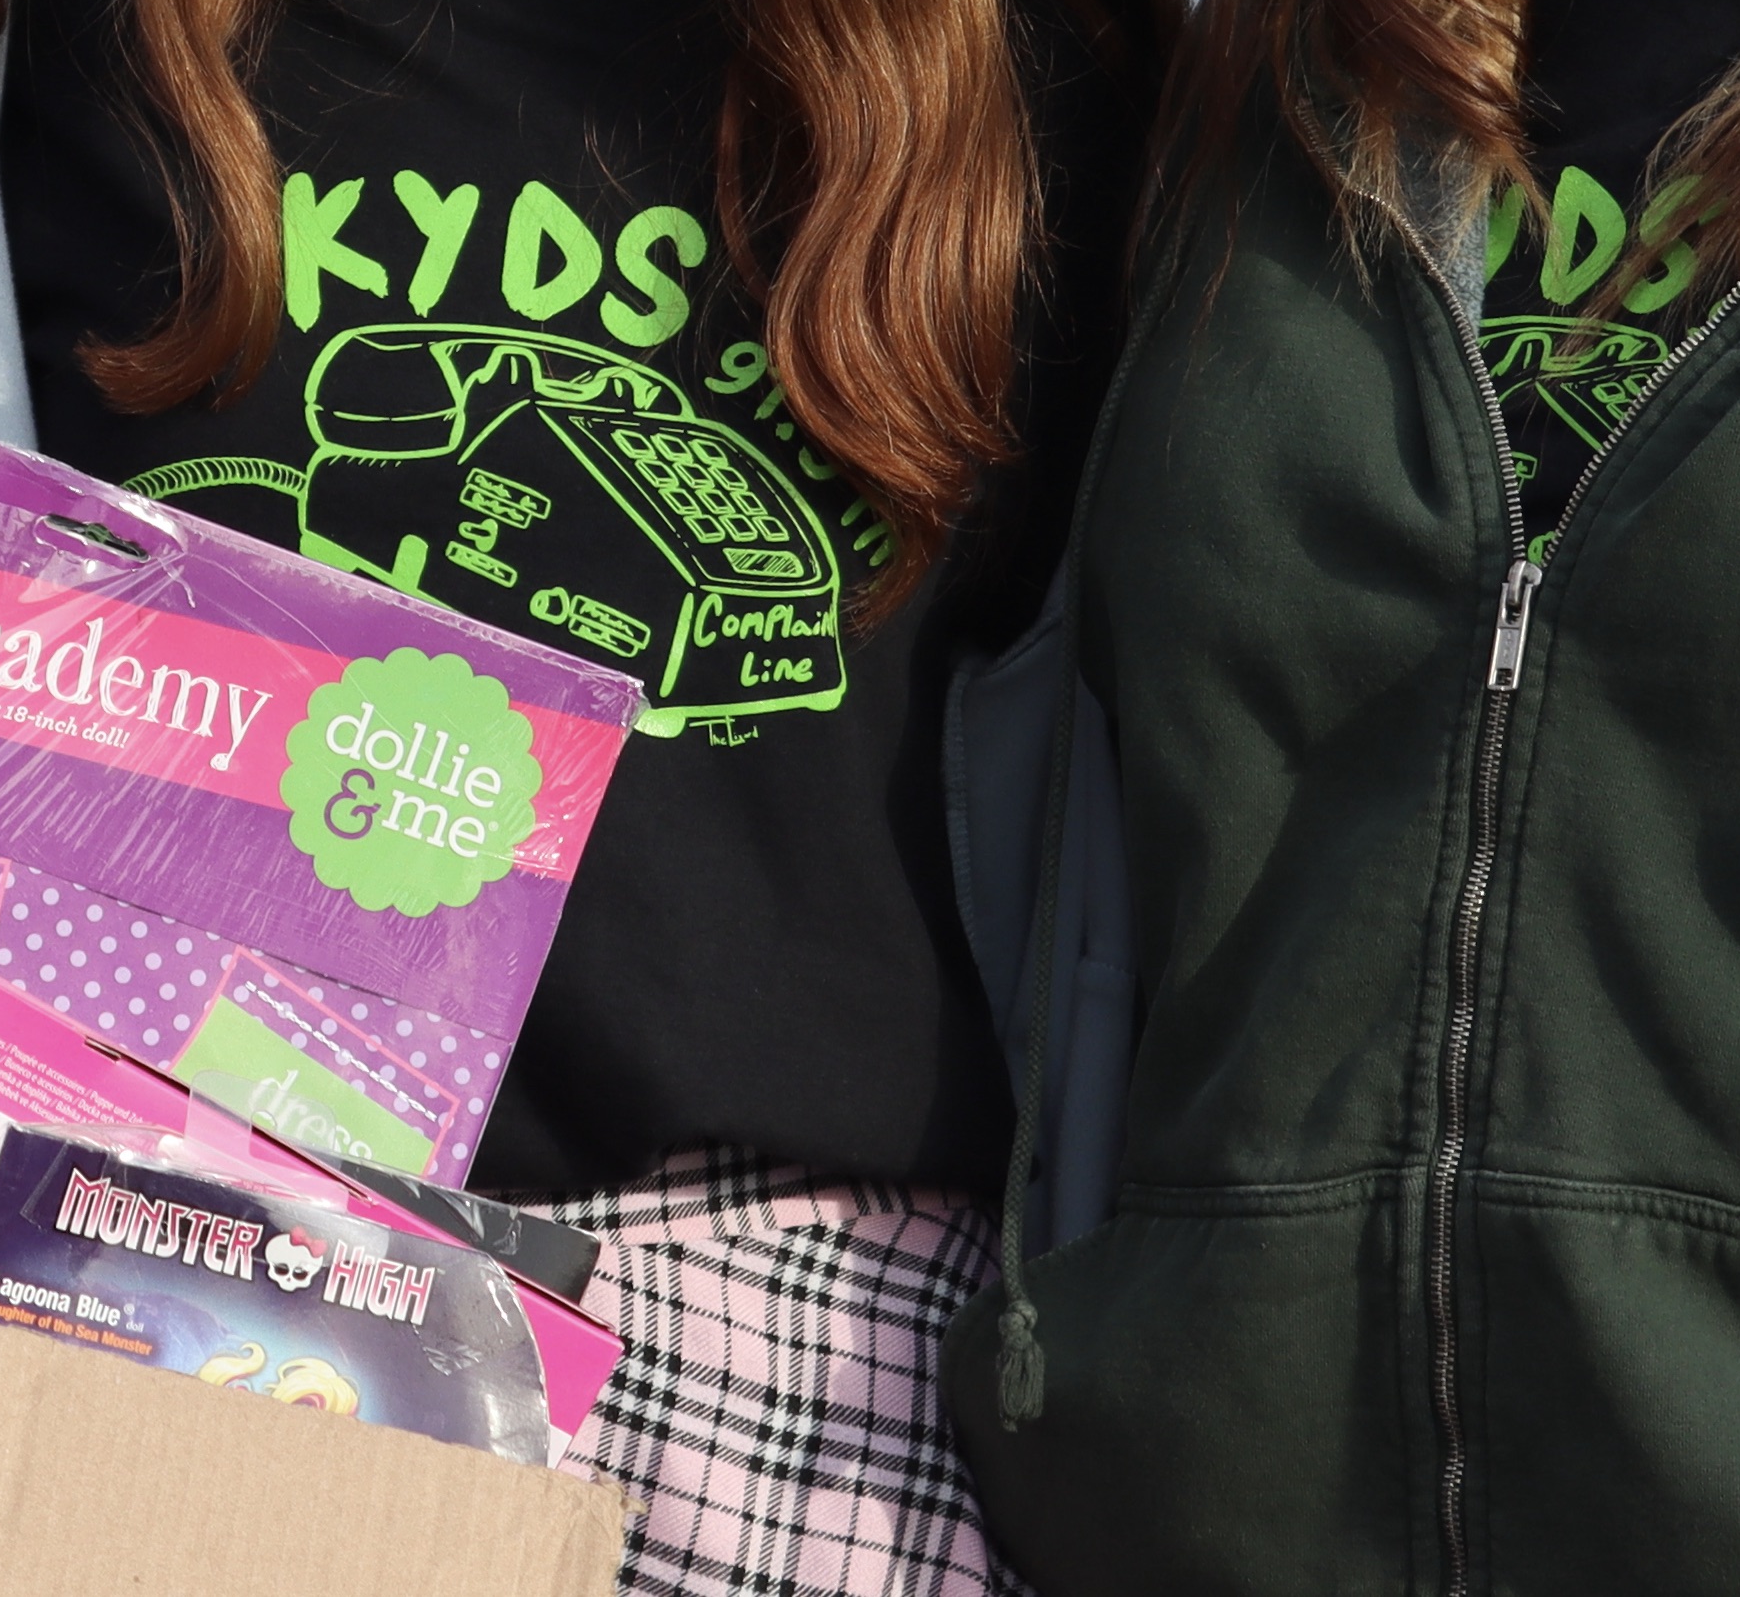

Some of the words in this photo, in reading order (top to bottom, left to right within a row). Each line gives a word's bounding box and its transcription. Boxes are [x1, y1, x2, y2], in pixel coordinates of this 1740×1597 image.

[282, 169, 706, 347] KYDS
[740, 652, 813, 687] Line
[3, 704, 78, 737] 18-inch
[82, 723, 131, 748] doll!
[326, 701, 502, 808] dollie
[324, 768, 382, 840] &
[56, 1168, 263, 1280] MONSTER
[323, 1239, 435, 1326] HIGH
[38, 1315, 53, 1329] of
[53, 1319, 73, 1334] the
[75, 1324, 99, 1342] Sea
[101, 1331, 153, 1356] Monster
[76, 1294, 121, 1326] Blue
[126, 1320, 145, 1333] doll
